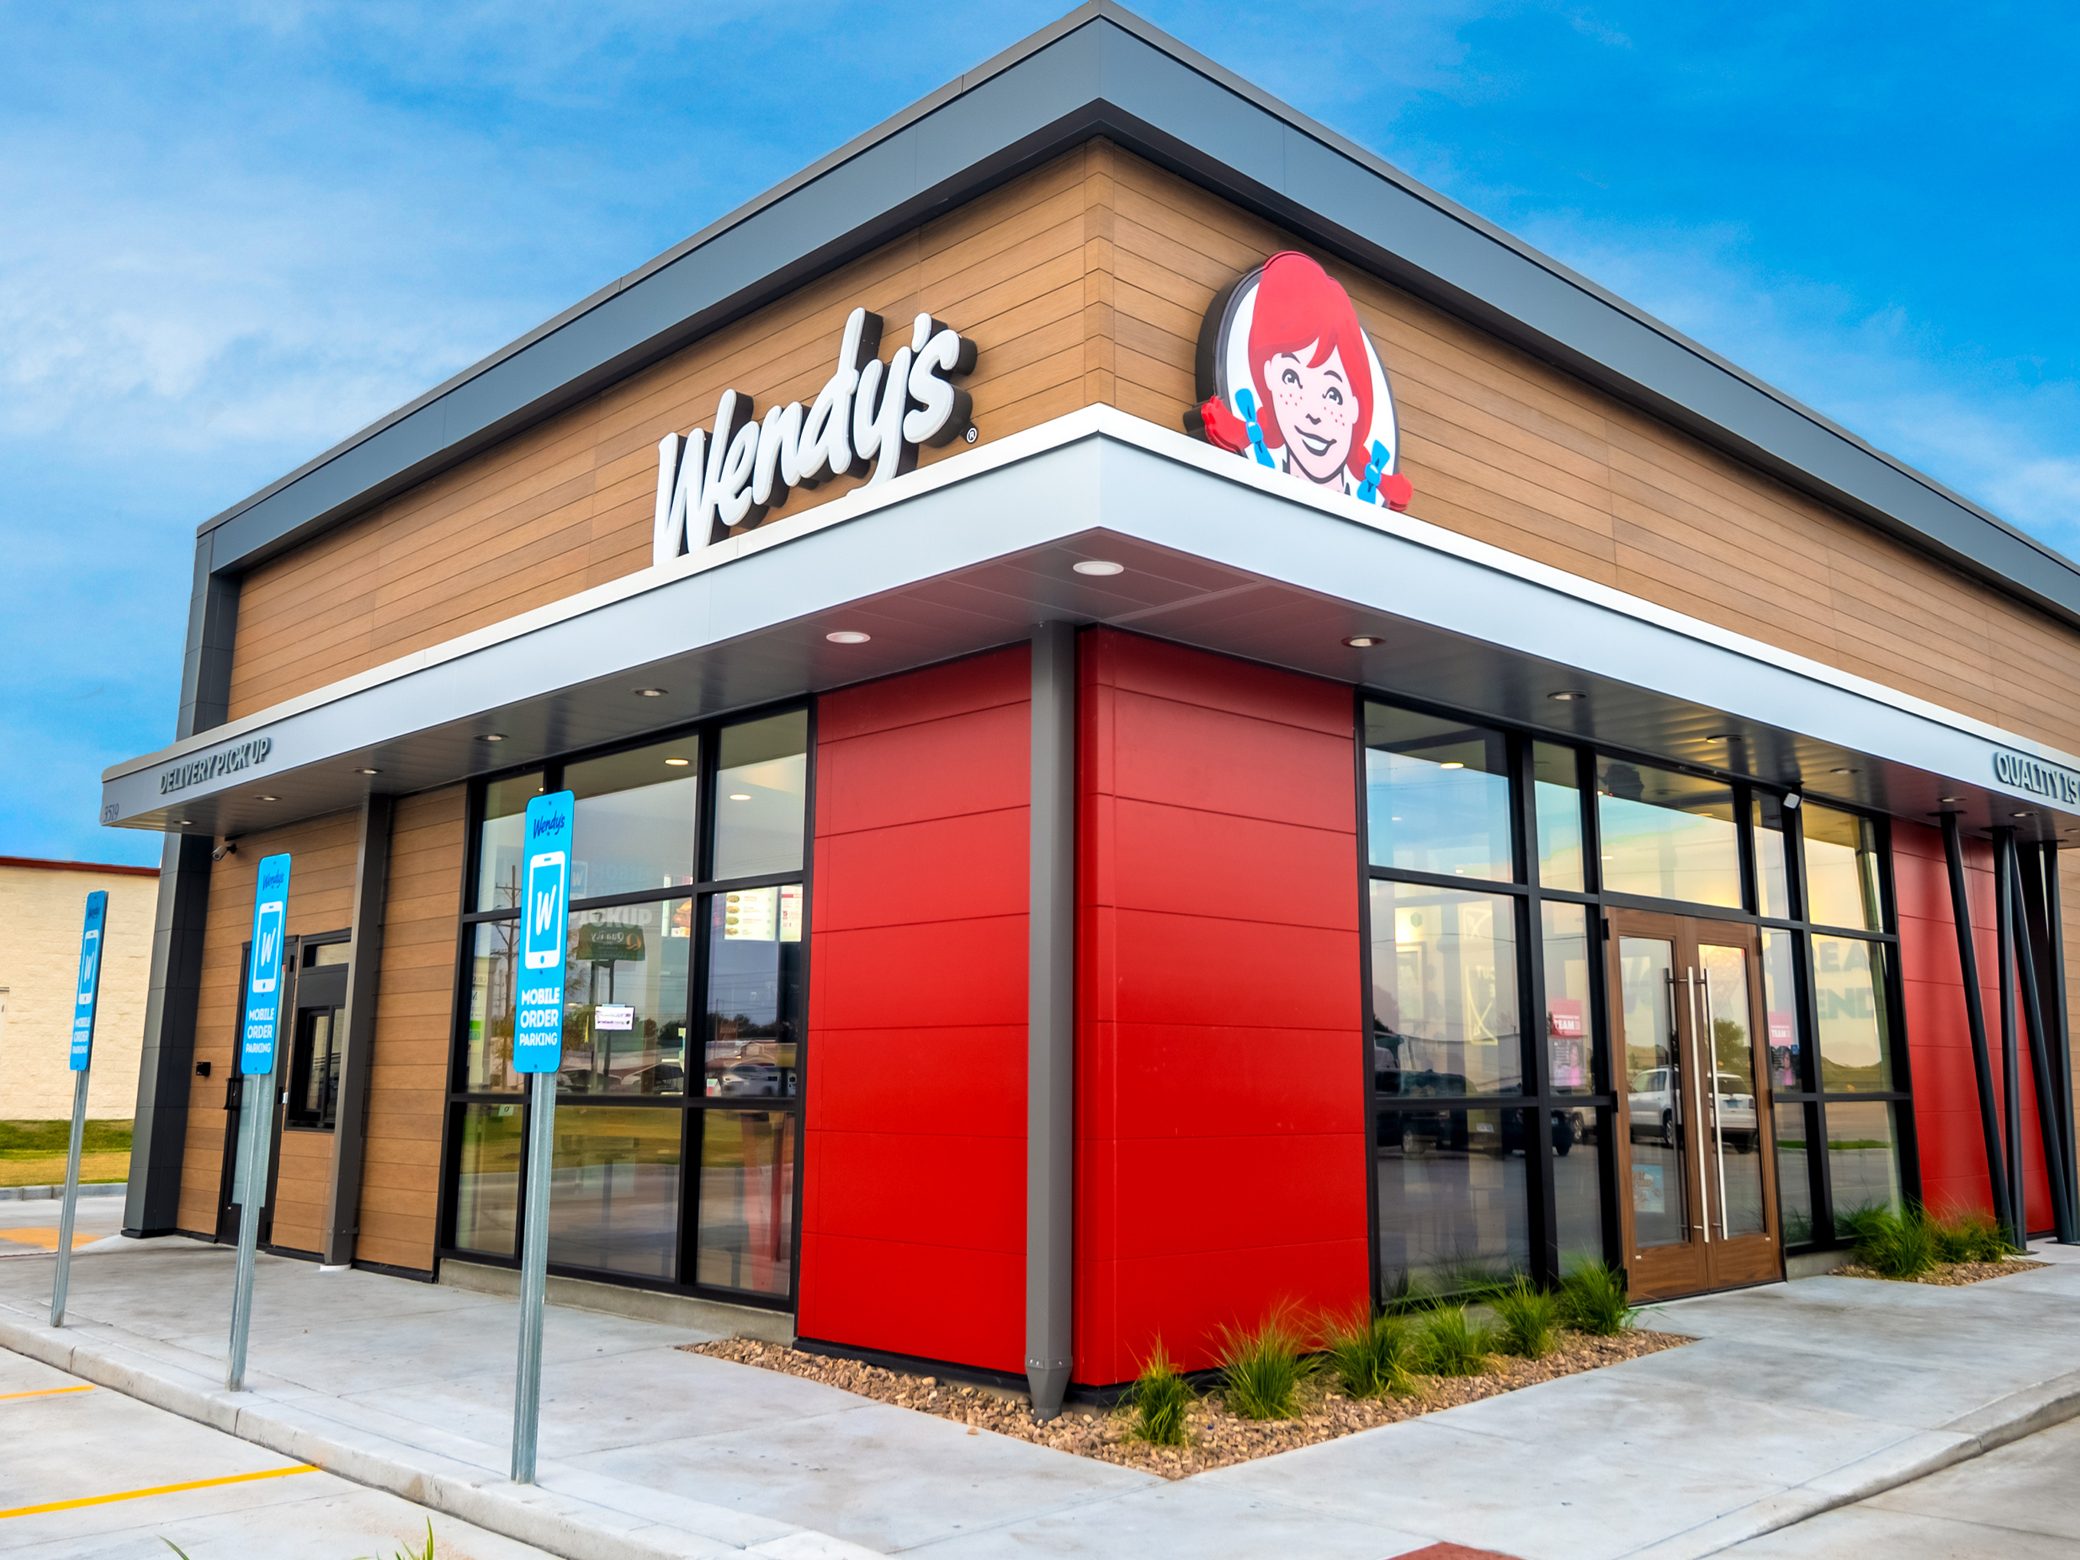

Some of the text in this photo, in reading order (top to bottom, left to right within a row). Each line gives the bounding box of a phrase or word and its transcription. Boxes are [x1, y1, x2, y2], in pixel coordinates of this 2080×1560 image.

[653, 307, 967, 566] Wendy's
[160, 736, 271, 794] DELIVERY PICK UP
[1993, 752, 2078, 804] QUALITY IS
[533, 810, 565, 839] Wendy's
[521, 987, 560, 1006] MOBILE
[249, 1008, 274, 1021] MOBILE
[519, 1008, 558, 1028] ORDER
[247, 1025, 272, 1039] ORDER
[518, 1032, 557, 1047] PARKING
[245, 1042, 271, 1054] PARKING
